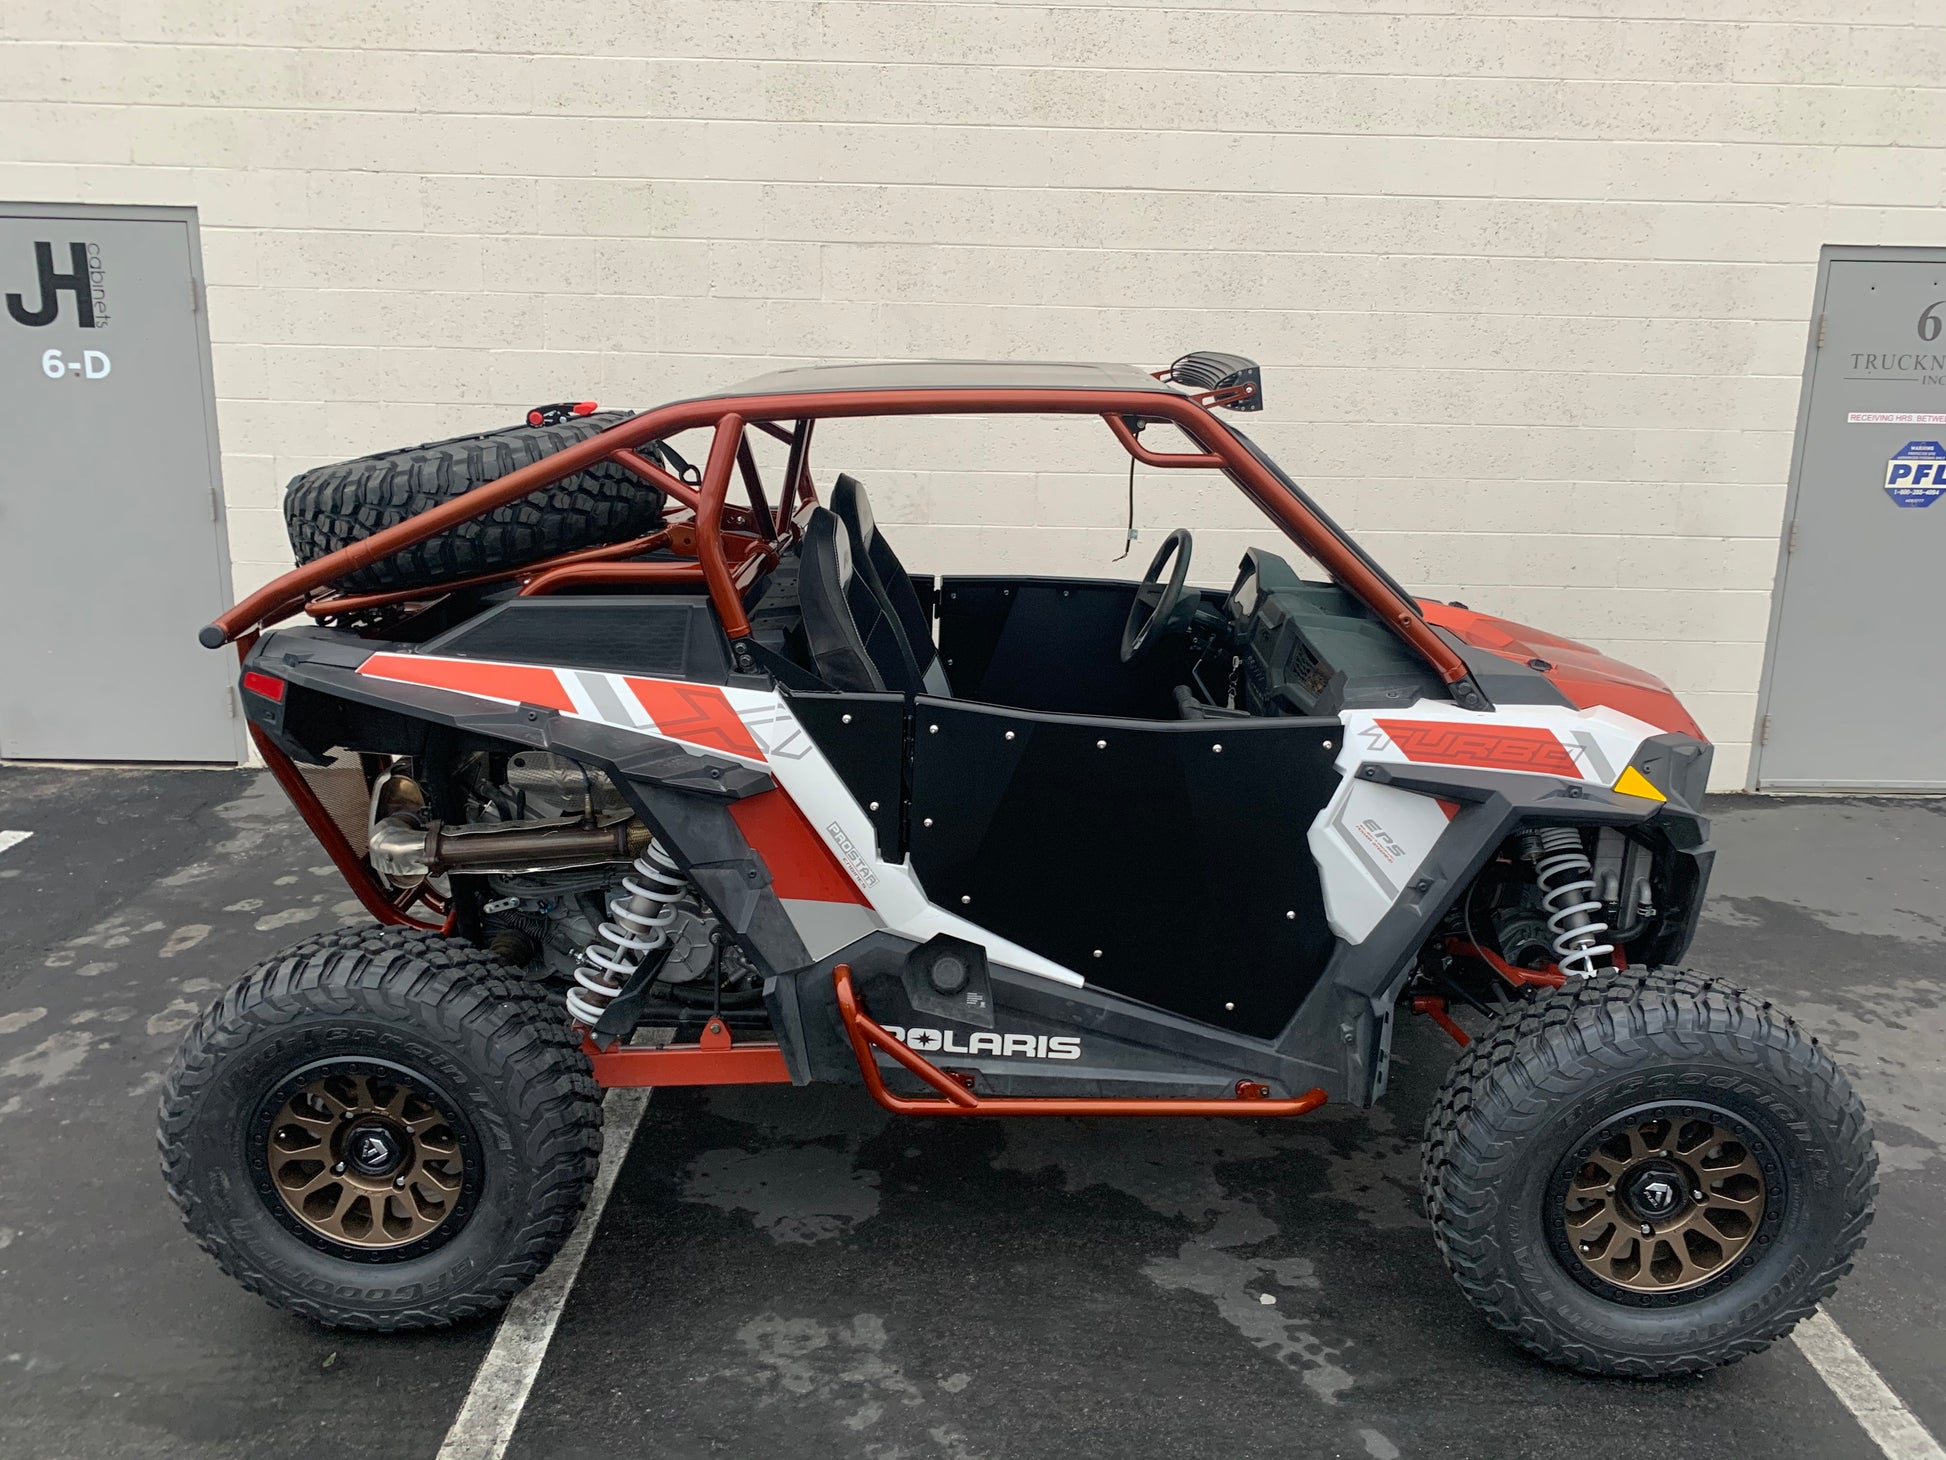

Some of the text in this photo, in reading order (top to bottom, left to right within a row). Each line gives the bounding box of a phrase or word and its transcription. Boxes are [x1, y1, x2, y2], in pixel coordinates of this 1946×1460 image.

[5, 241, 96, 328] JH
[86, 242, 112, 329] cabinets
[41, 348, 112, 379] 6-D
[1850, 414, 1894, 422] RECEIVING
[1358, 725, 1587, 770] TURBO
[827, 821, 880, 888] PROSTAR
[1362, 818, 1406, 857] EPS
